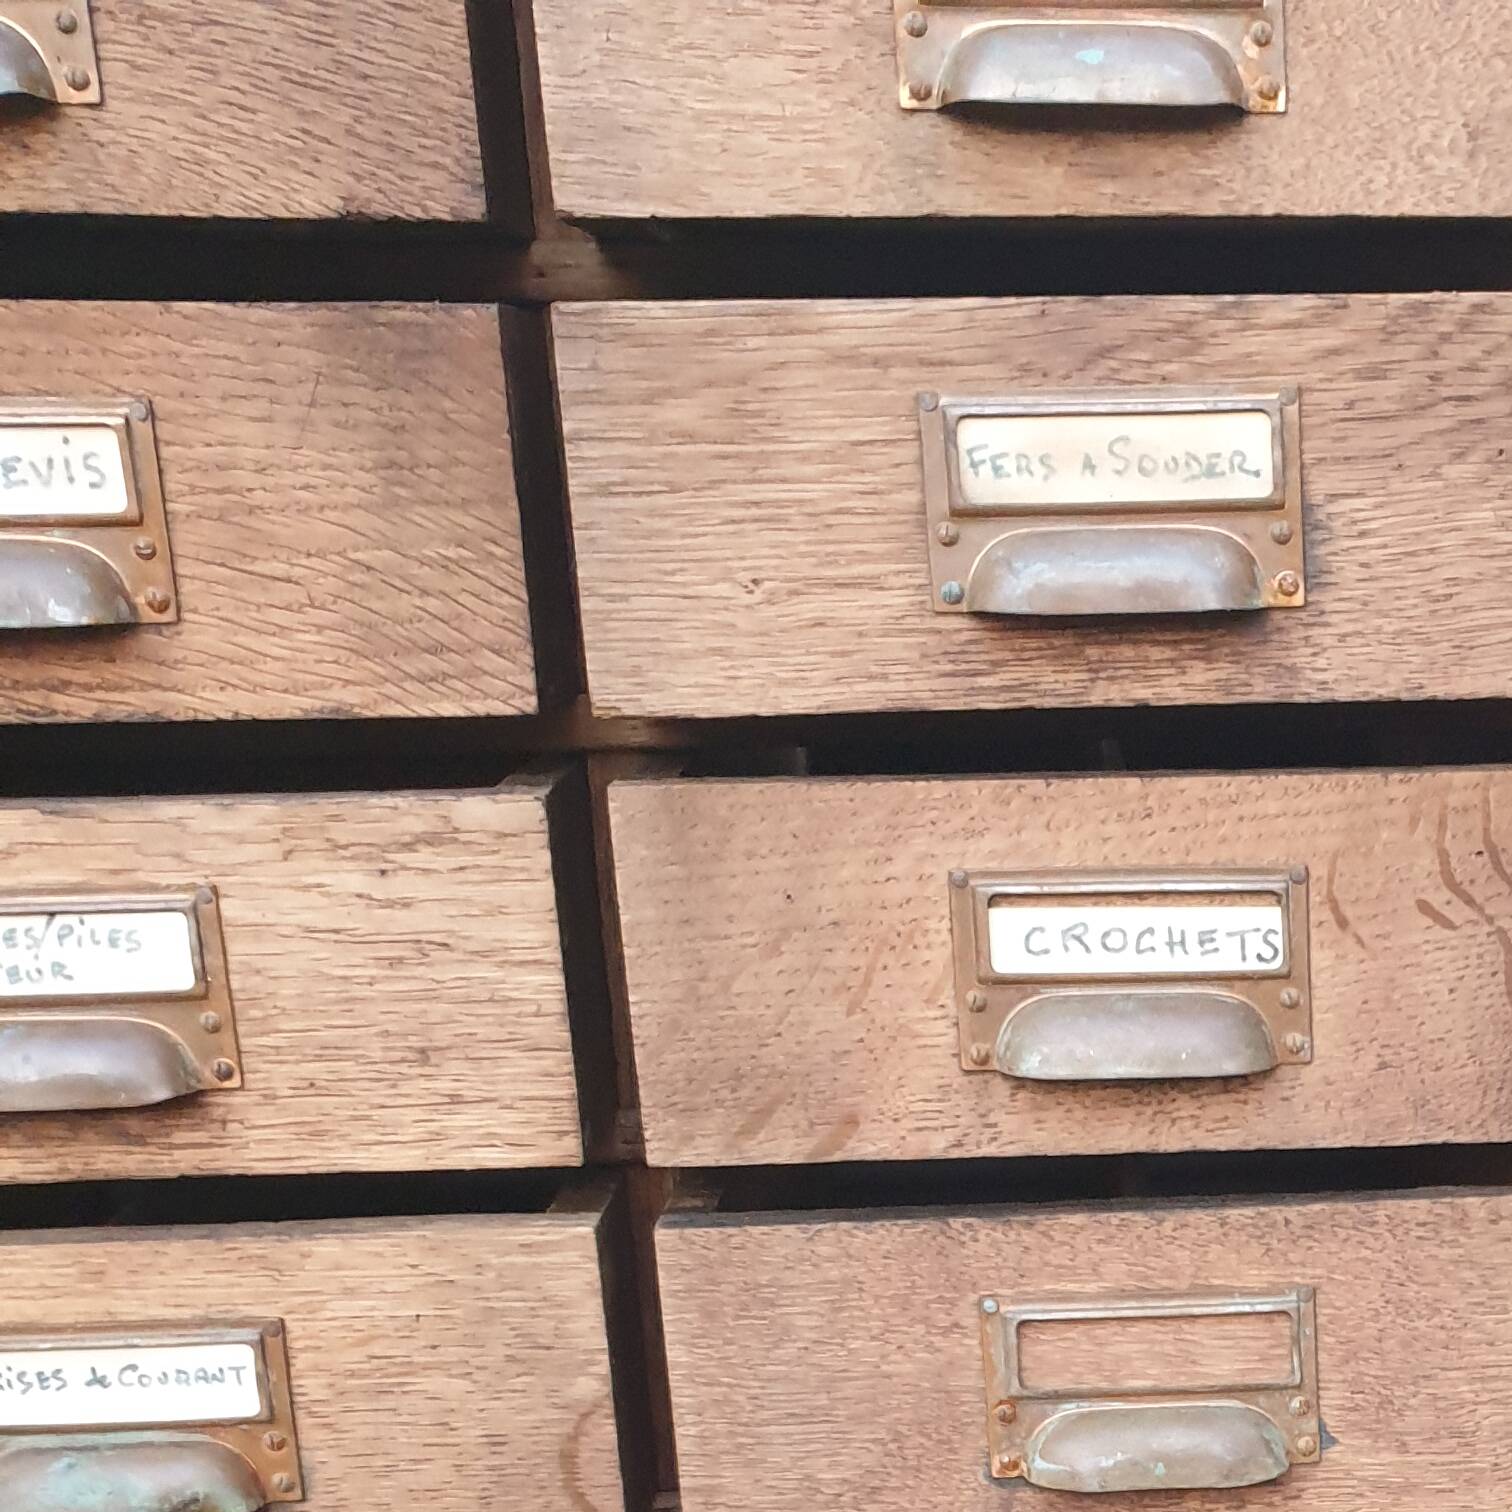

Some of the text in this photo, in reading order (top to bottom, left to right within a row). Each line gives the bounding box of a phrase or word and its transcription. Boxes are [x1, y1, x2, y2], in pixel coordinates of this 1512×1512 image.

[966, 443, 1056, 481] FERS
[1107, 434, 1261, 483] SOUDER
[1024, 922, 1279, 964] CROCHETS
[117, 1363, 247, 1388] COURANT
